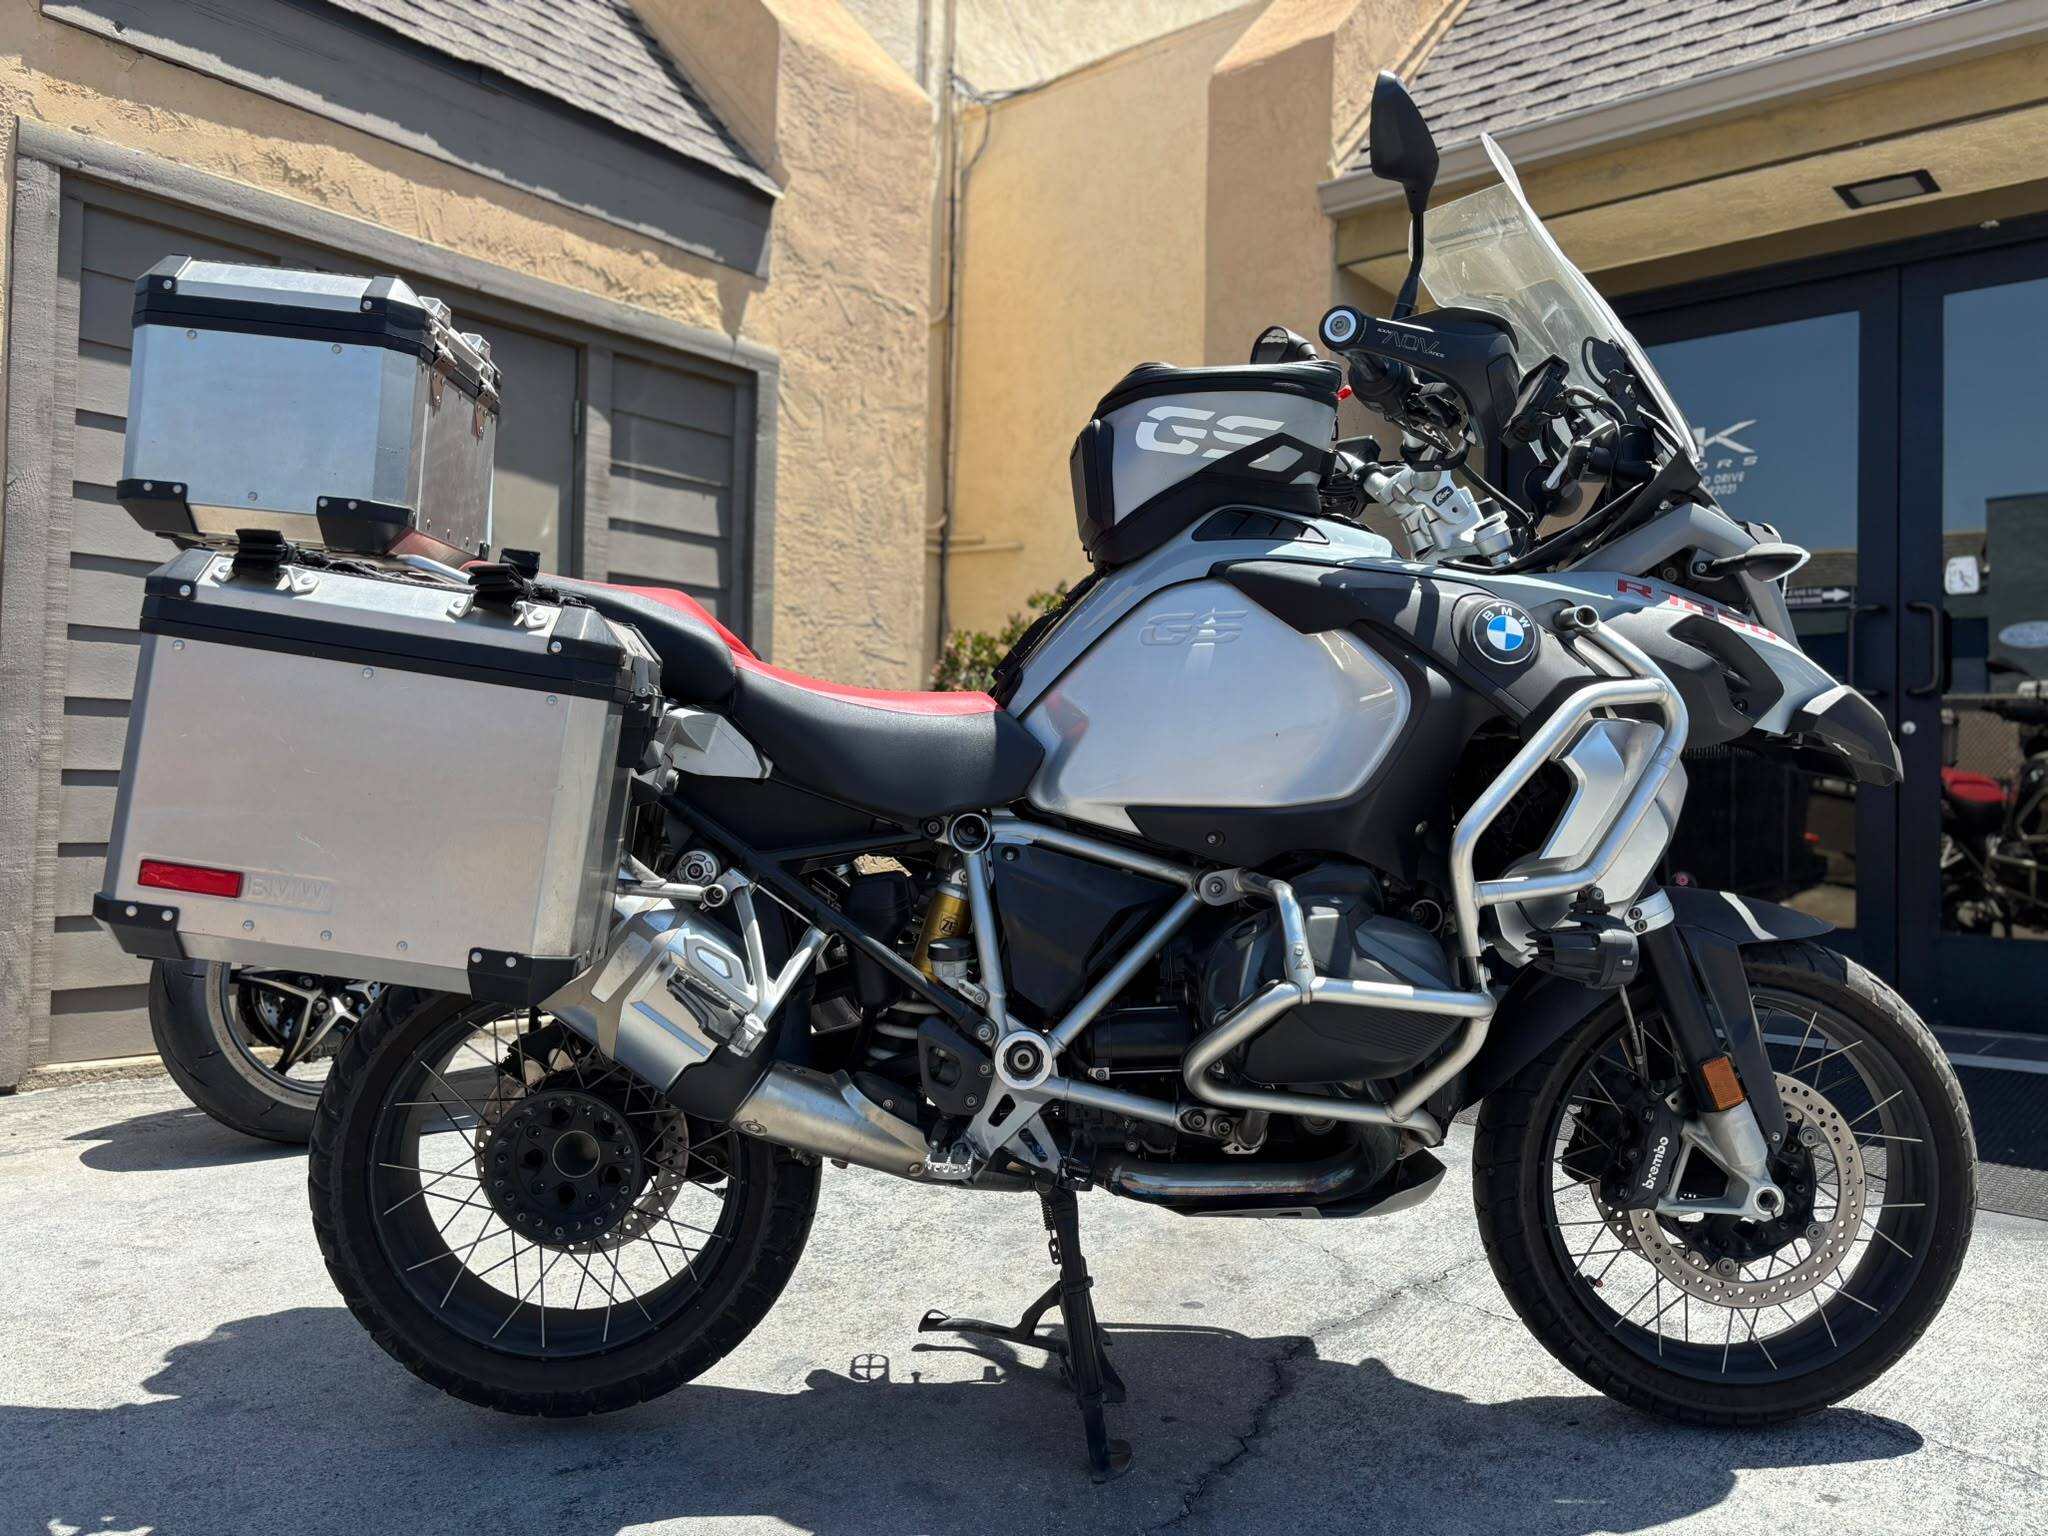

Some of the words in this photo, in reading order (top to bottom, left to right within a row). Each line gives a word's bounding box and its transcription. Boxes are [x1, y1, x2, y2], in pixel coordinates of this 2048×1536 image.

[1135, 405, 1286, 459] GS
[1697, 456, 1758, 469] ORS
[1617, 578, 1653, 599] R
[1139, 610, 1248, 646] GS
[1482, 606, 1531, 629] BMW
[248, 876, 330, 903] BMW
[1641, 1136, 1669, 1190] brembo
